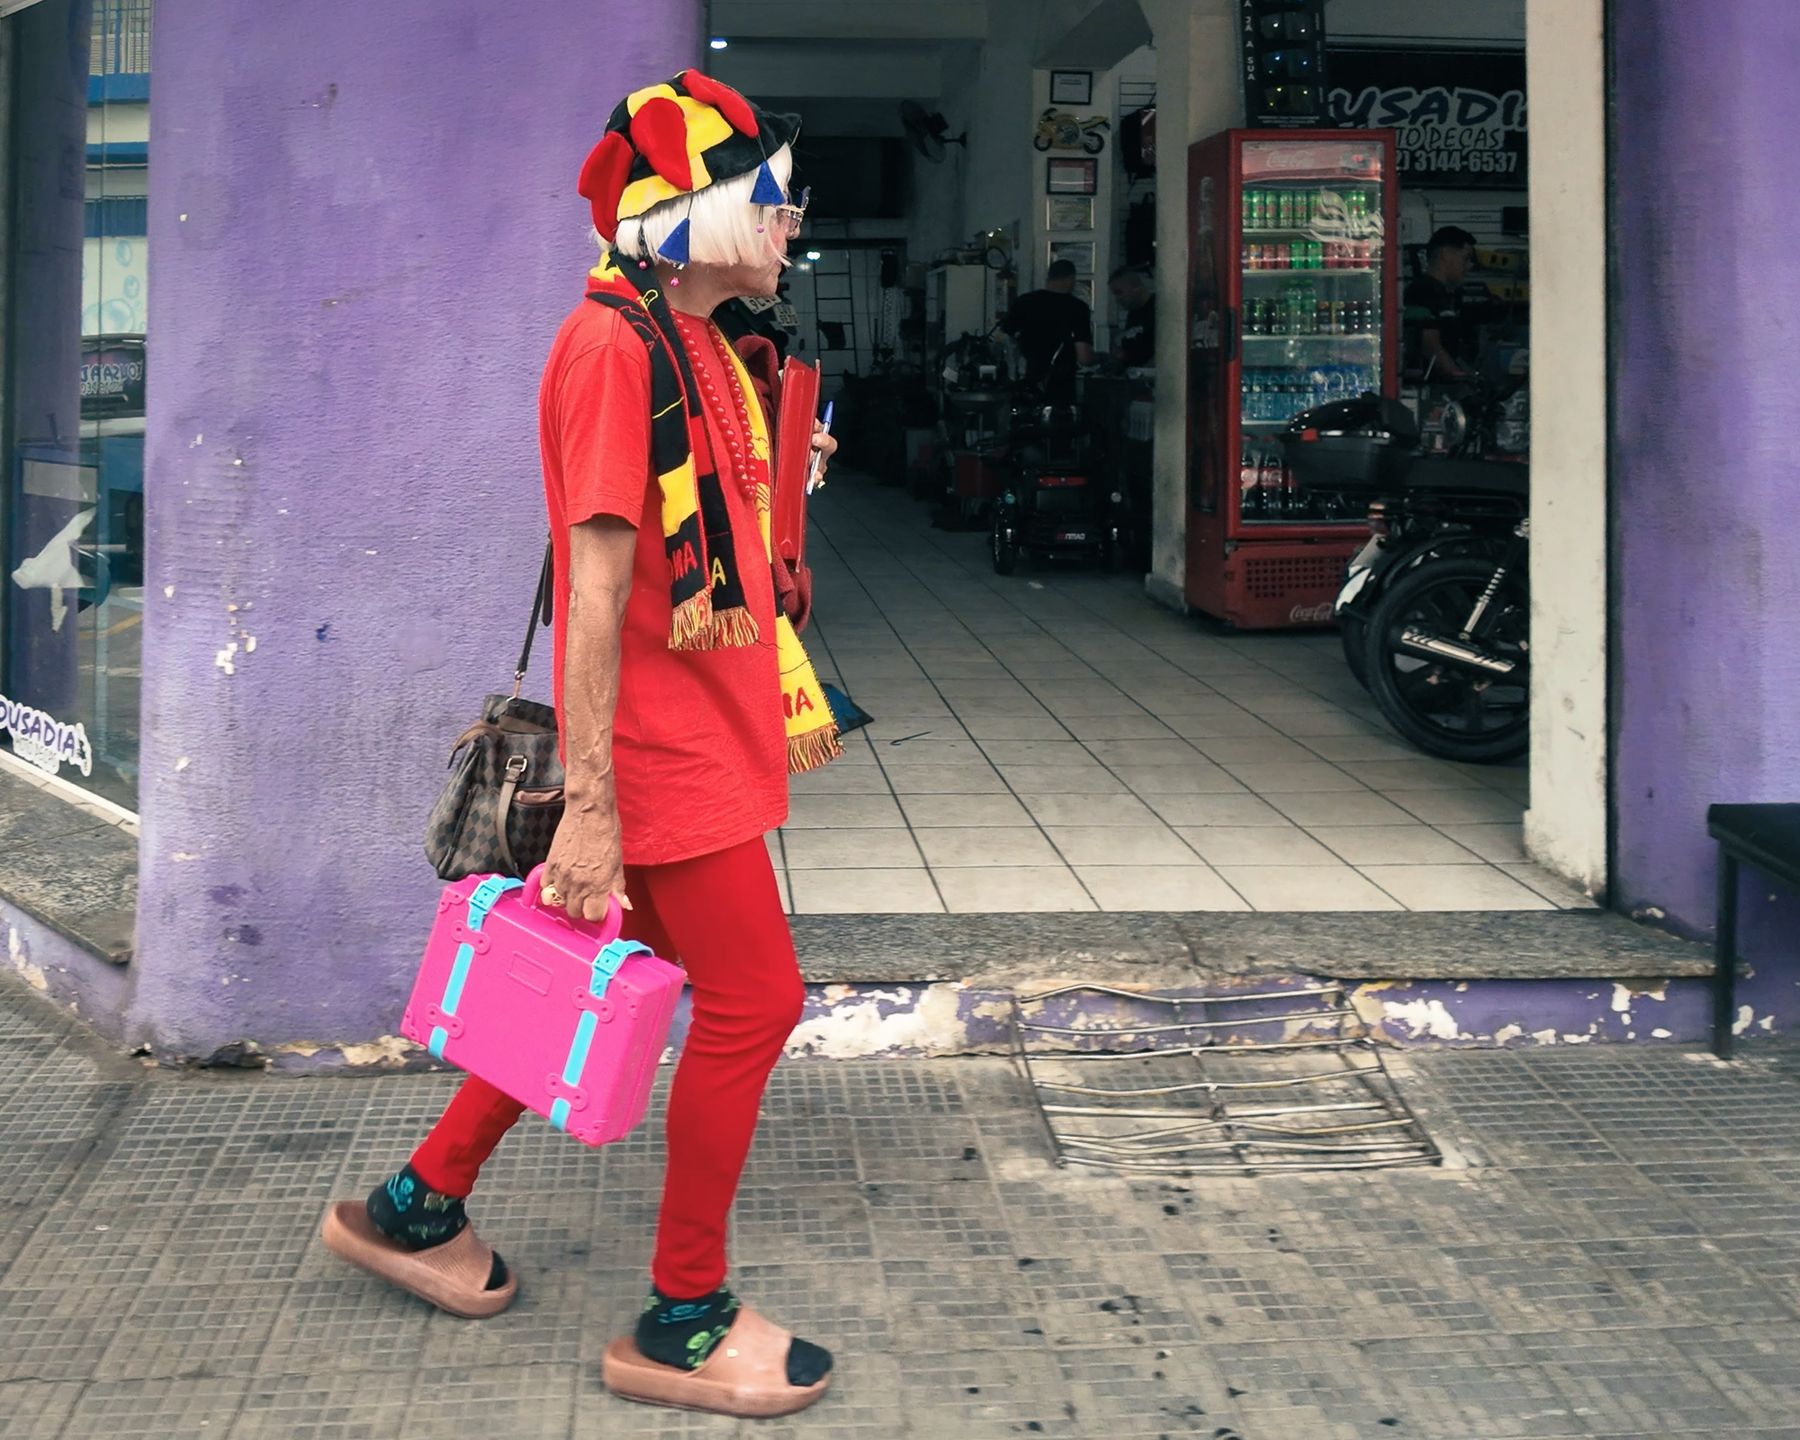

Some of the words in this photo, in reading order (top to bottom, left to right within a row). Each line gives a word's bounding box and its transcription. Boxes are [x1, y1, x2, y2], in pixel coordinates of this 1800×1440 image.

[1247, 56, 1256, 80] SUA
[1329, 87, 1527, 128] USADI
[1395, 127, 1421, 146] TO
[1414, 150, 1518, 172] 3144-6537
[711, 556, 727, 589] A
